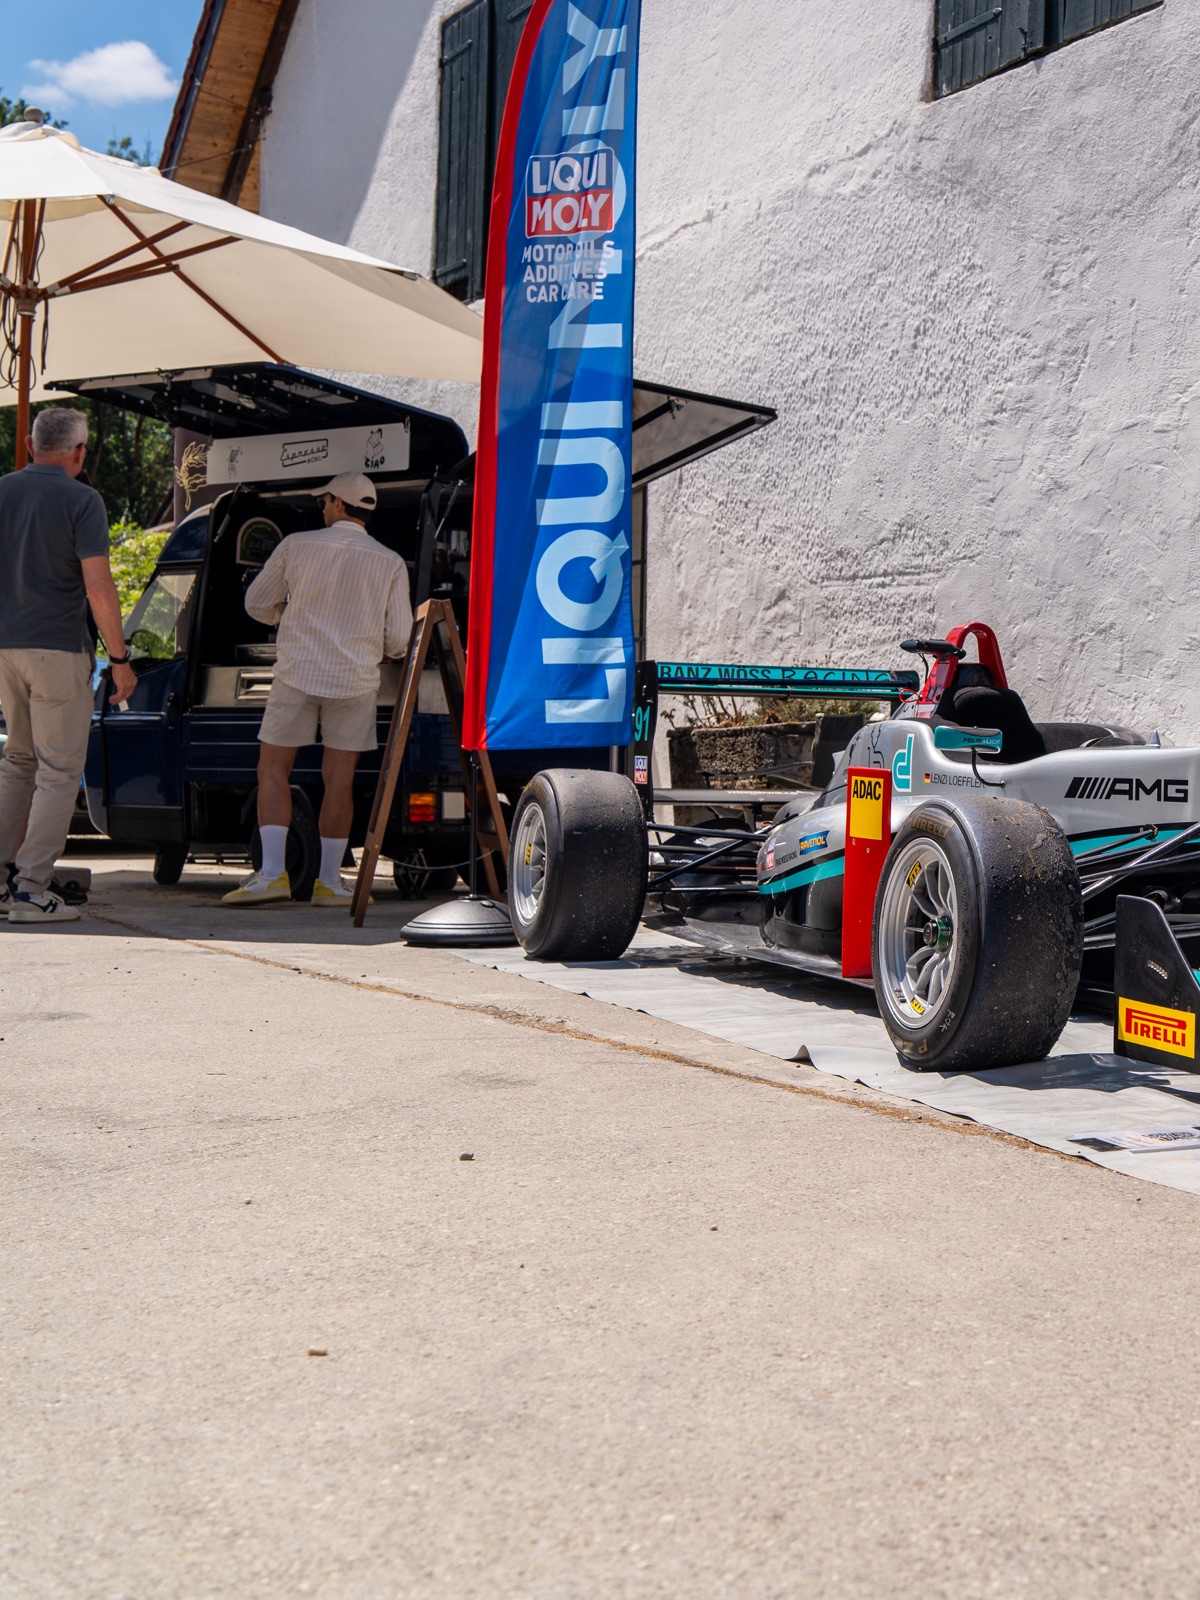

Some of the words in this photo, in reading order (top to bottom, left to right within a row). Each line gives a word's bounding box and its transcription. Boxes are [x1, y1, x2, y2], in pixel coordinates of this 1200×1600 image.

[532, 152, 607, 194] LIQUI
[531, 194, 610, 232] MOLY
[522, 243, 573, 263] MOTOR
[575, 240, 615, 259] OILS
[523, 261, 607, 283] ADDITIVES
[526, 284, 558, 303] CAR
[561, 281, 604, 300] CARE
[280, 445, 328, 462] Espresso
[536, 400, 630, 723] LIQUI
[659, 665, 712, 679] RANZ
[634, 706, 650, 742] 91
[852, 779, 882, 801] ADAC
[931, 773, 948, 784] LENZI
[1105, 777, 1188, 802] AMG
[911, 811, 953, 839] PIRELLI
[800, 836, 825, 852] RAVENOL
[1125, 1007, 1187, 1047] PIRELLI
